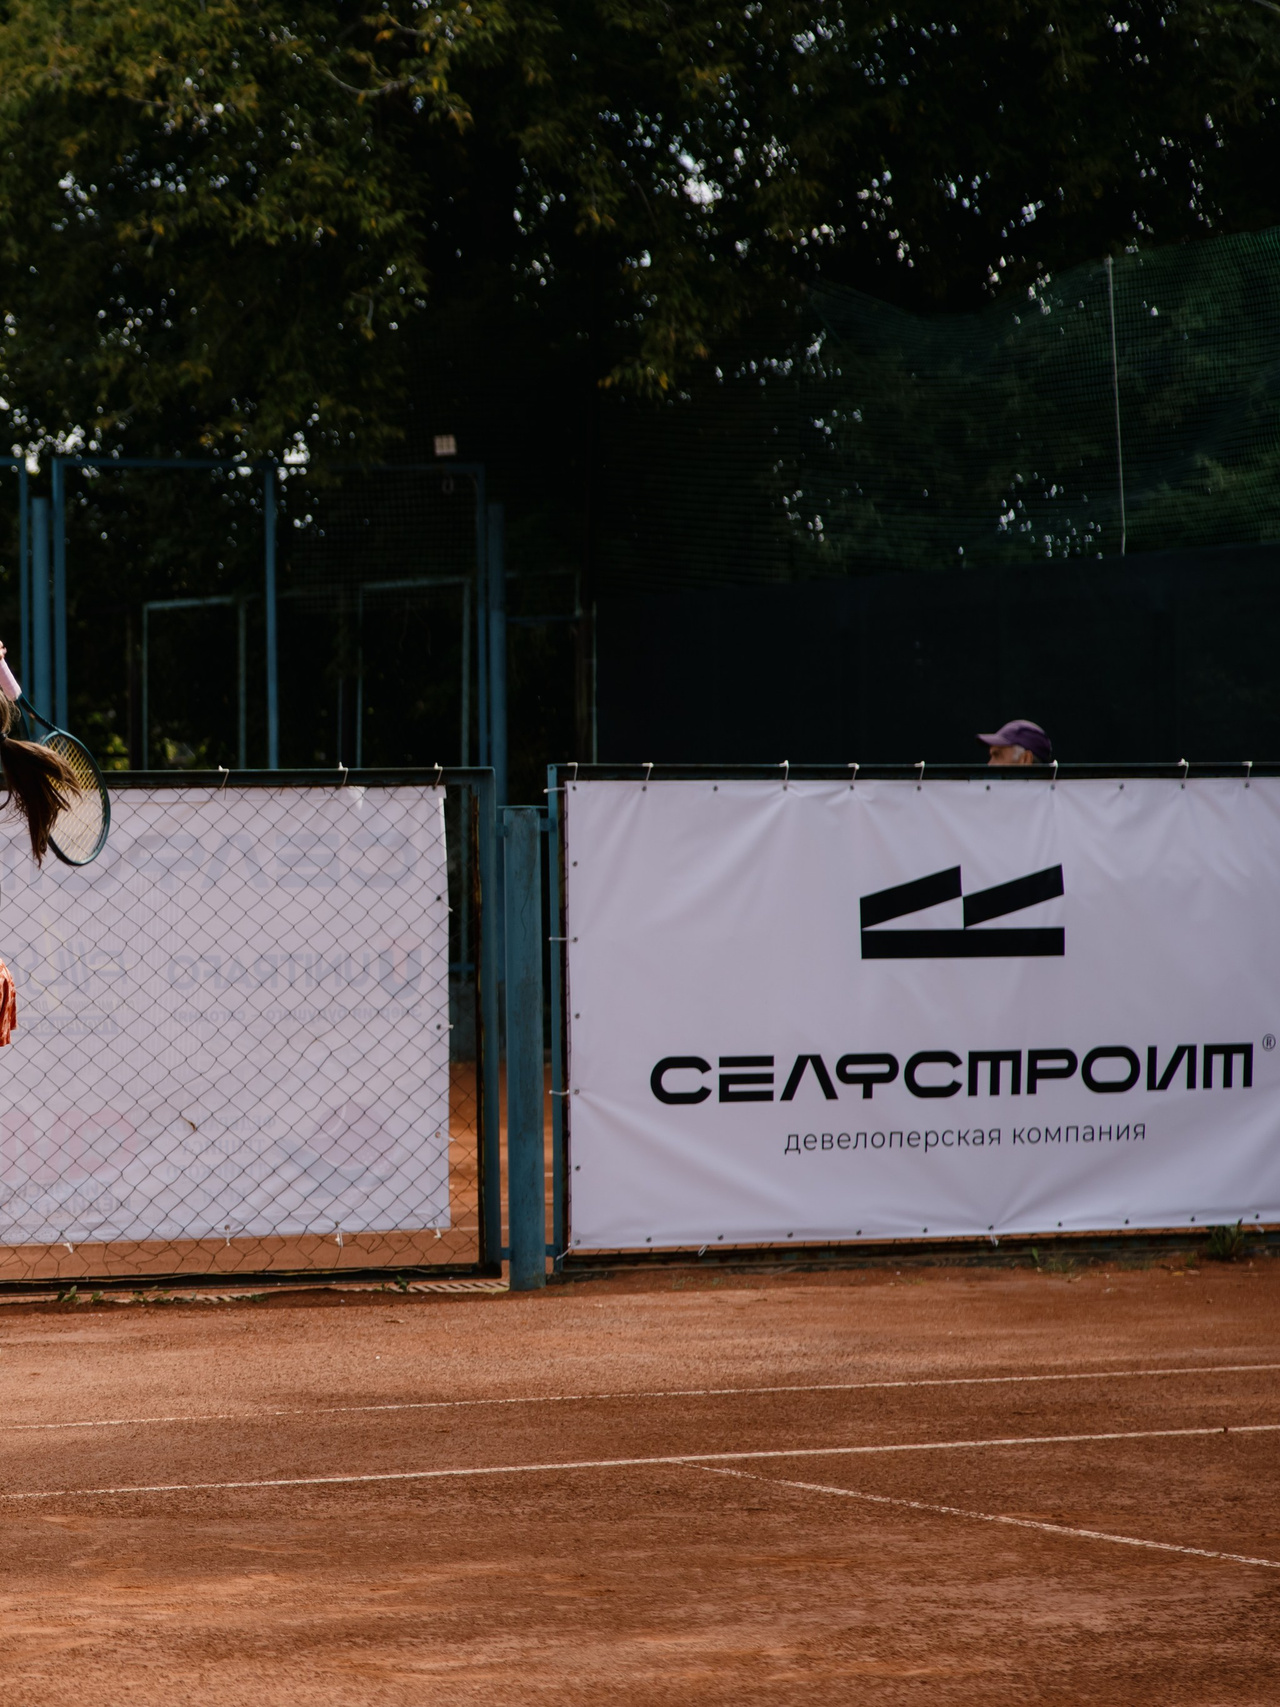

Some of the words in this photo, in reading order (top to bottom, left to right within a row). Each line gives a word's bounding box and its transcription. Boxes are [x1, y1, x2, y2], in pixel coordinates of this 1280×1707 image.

[650, 1043, 1254, 1105] СЕЛФСТРОИТ
[784, 1128, 1002, 1155] девелоперская
[1012, 1122, 1147, 1146] компания
